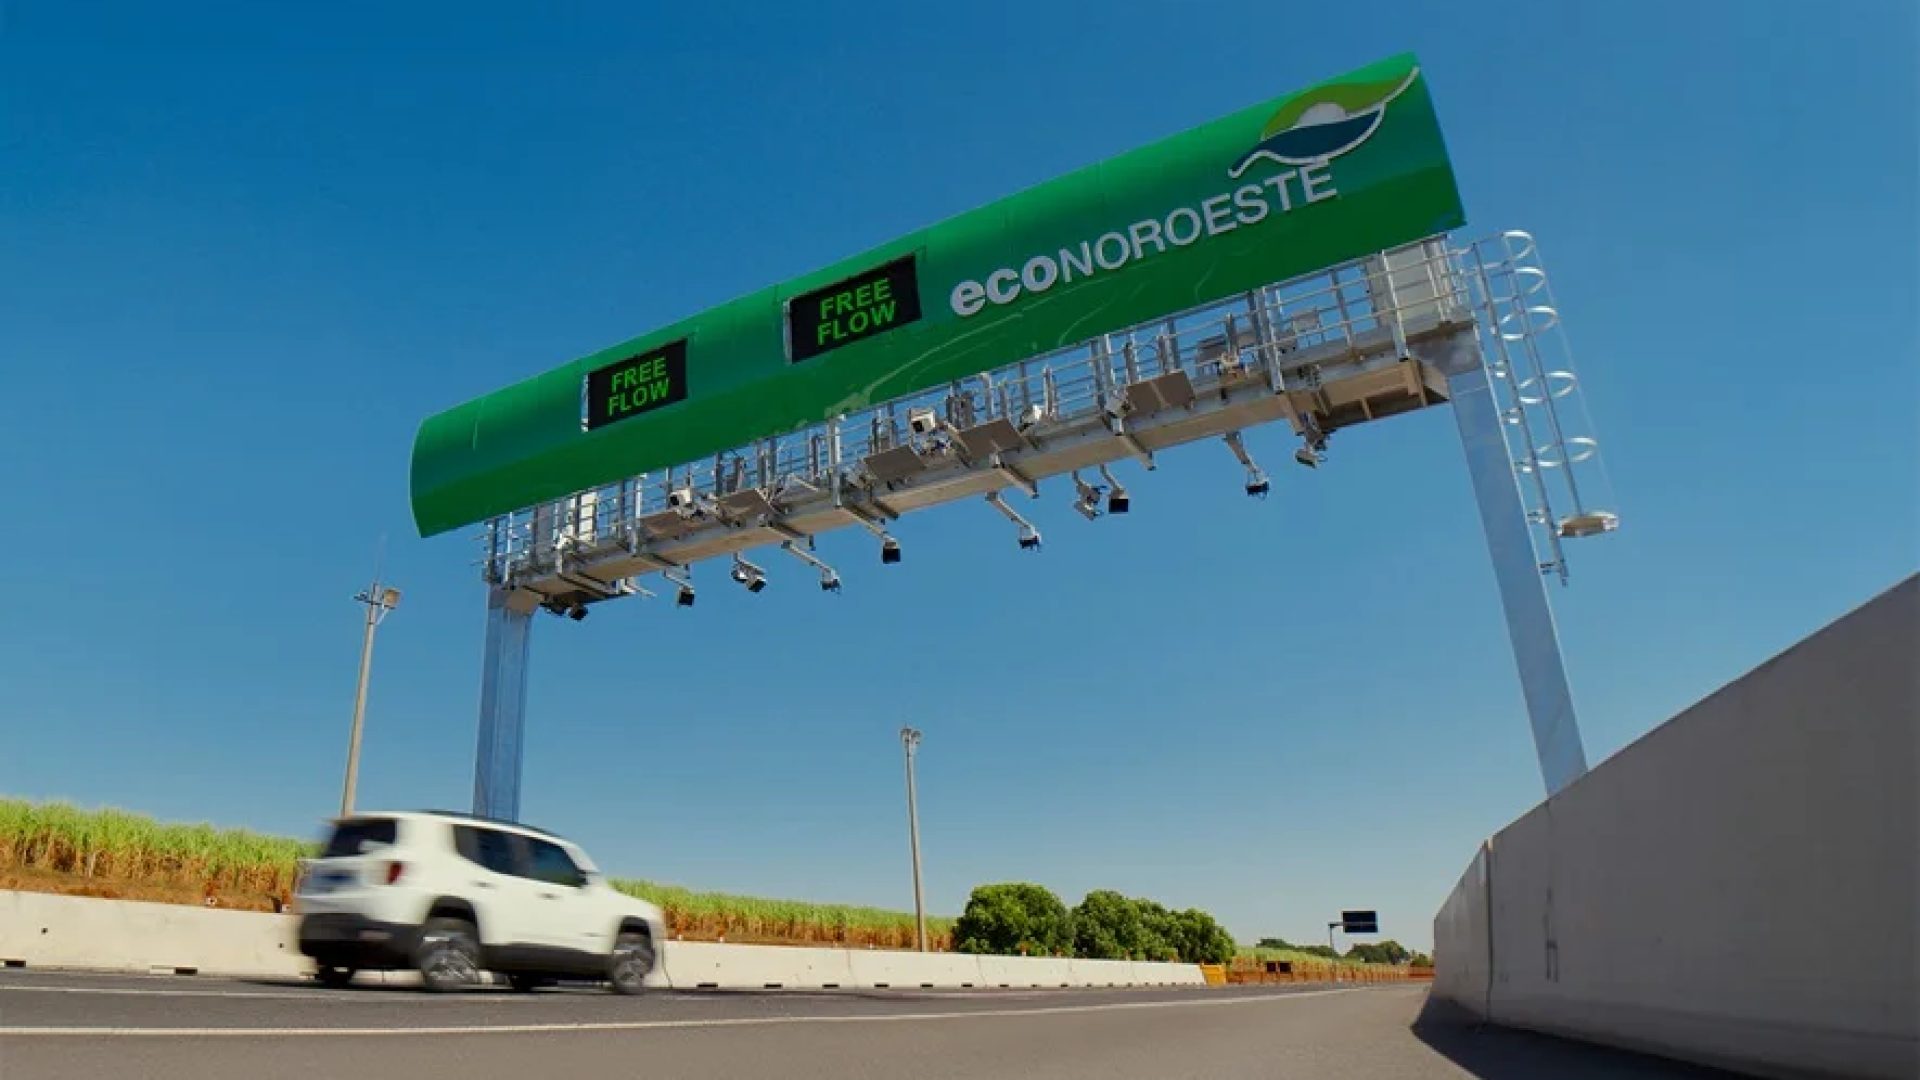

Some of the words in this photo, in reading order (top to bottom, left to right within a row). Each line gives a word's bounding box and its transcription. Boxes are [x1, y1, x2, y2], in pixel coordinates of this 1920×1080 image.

[951, 160, 1337, 317] ecoNOROESTE
[820, 277, 892, 320] FREE
[817, 301, 897, 346] FLOW
[608, 378, 668, 415] FLOW
[612, 357, 667, 393] FREE
